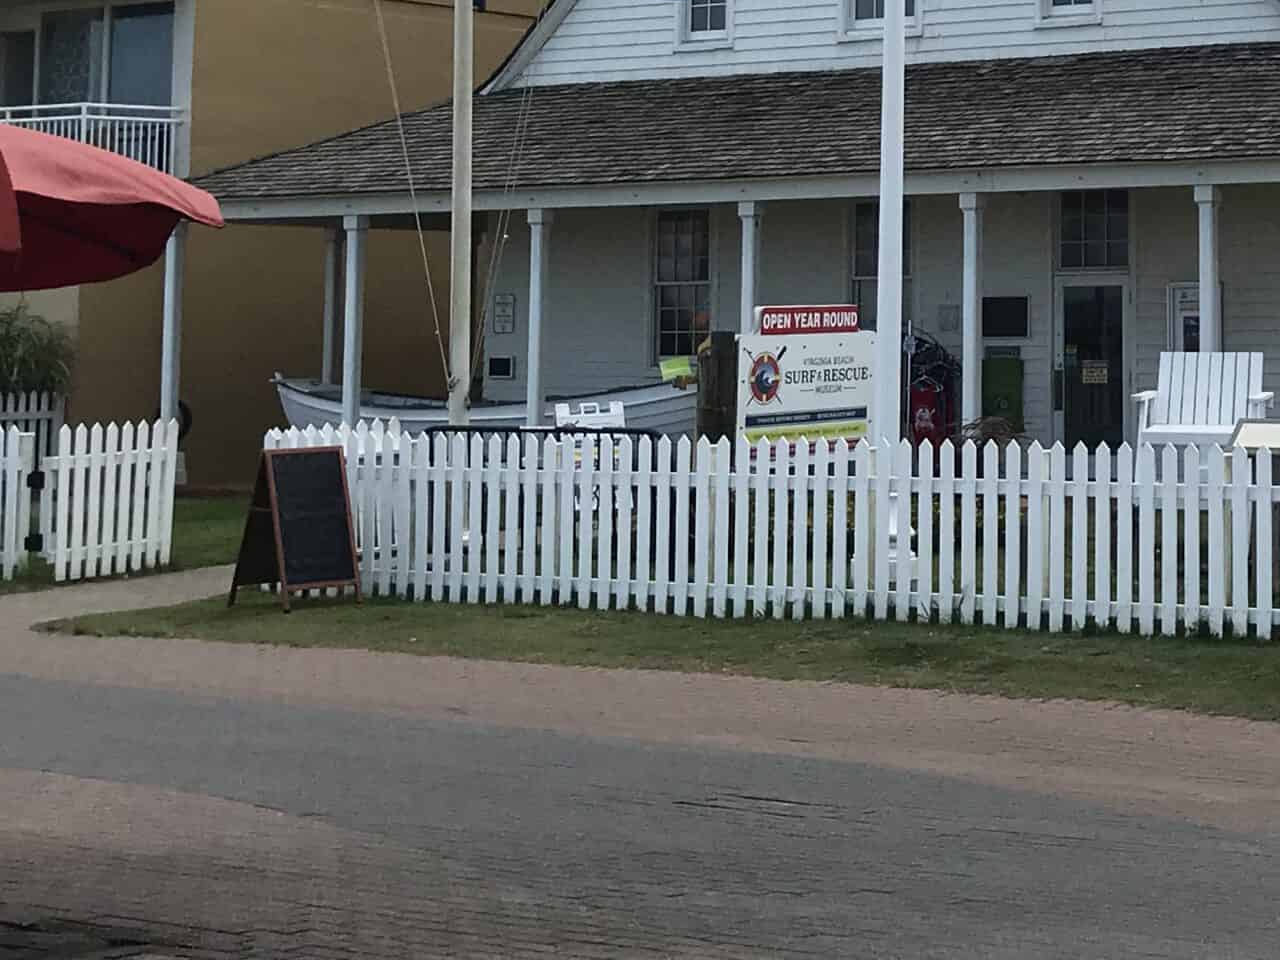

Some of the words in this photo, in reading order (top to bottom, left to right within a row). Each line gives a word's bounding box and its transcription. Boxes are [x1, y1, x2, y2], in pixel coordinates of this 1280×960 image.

[763, 313, 791, 329] OPEN
[794, 312, 821, 328] YEAR
[823, 311, 858, 327] ROUND
[784, 370, 816, 384] SURF
[823, 367, 869, 382] RESCUE
